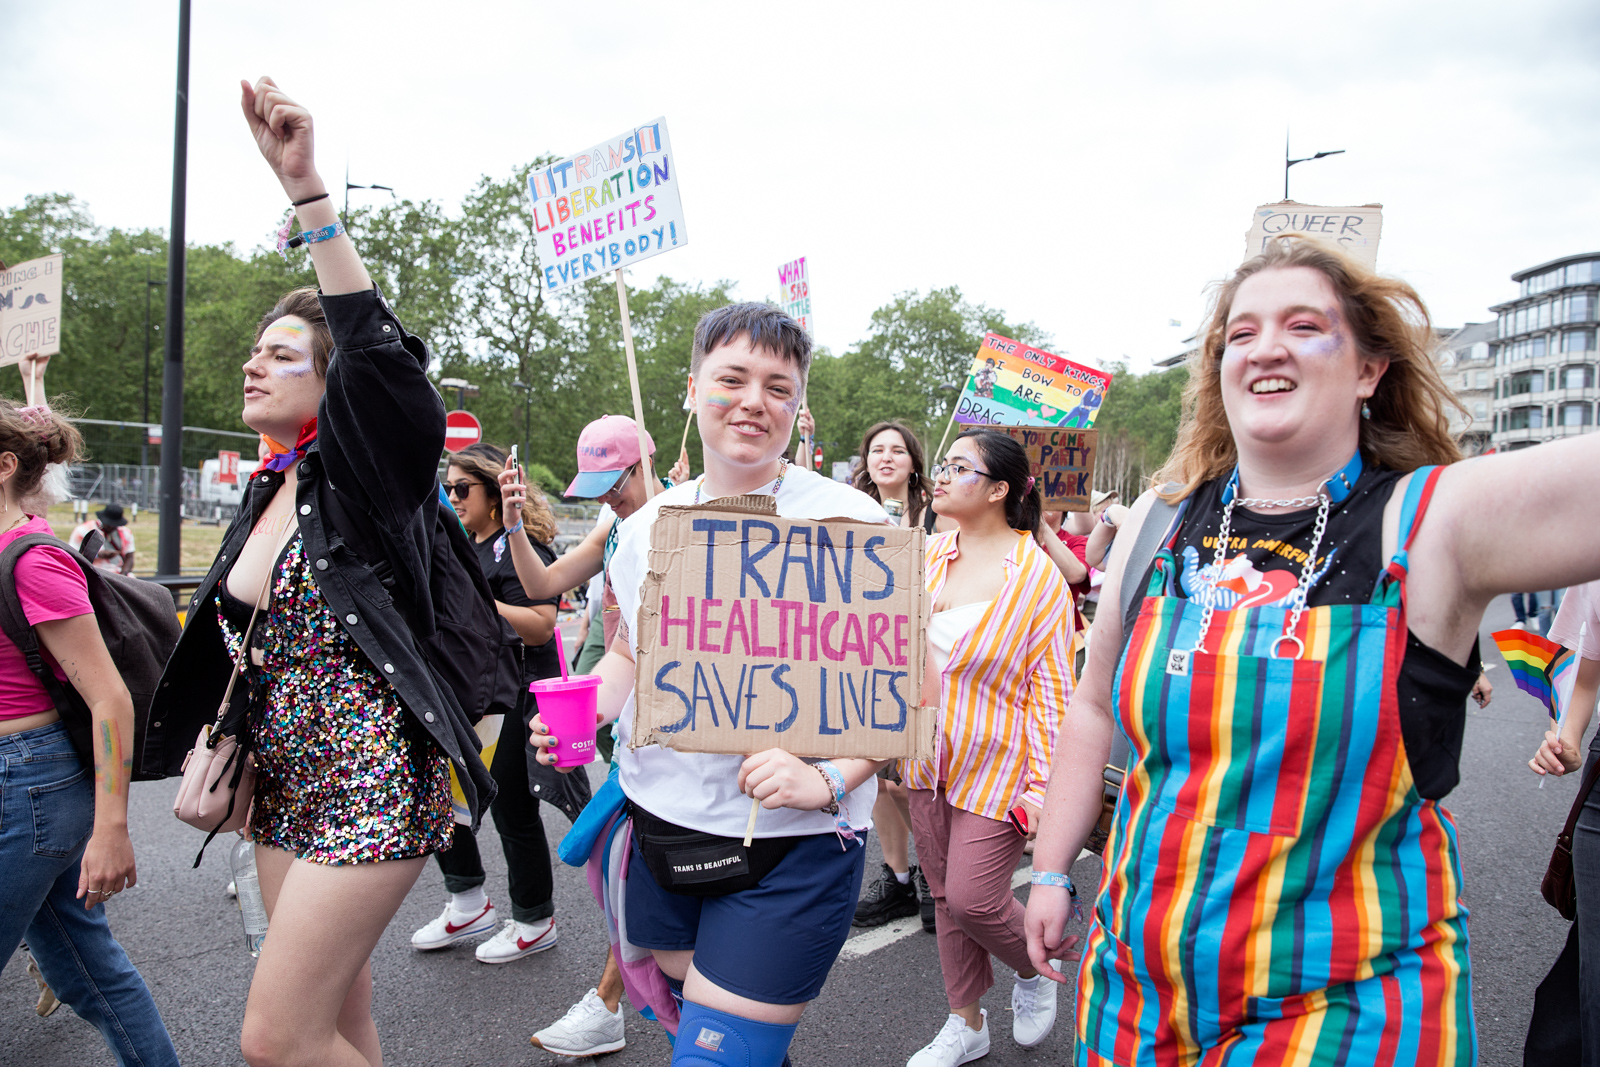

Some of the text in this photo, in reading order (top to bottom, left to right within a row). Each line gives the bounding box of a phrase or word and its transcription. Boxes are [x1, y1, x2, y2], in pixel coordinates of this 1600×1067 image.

[553, 136, 636, 189] TRANS
[533, 154, 670, 234] LIBERATION
[552, 195, 657, 257] BENEFITS
[1262, 213, 1364, 236] QUEER
[544, 220, 678, 289] EVERYBODY!
[778, 257, 805, 286] WHAT
[781, 281, 808, 303] A SAD
[0, 317, 57, 359] CHE
[988, 337, 1106, 387] THE ONLY KINGS
[996, 360, 1082, 397] I BOW TO
[1013, 384, 1043, 404] ARE
[1022, 430, 1046, 447] YOU
[1050, 431, 1085, 448] CAME
[1040, 445, 1091, 467] PARTY
[1043, 471, 1090, 498] WORK
[692, 518, 895, 604] TRANS
[660, 595, 909, 667] HEALTHCARE
[654, 660, 908, 736] SAVES LIVES
[571, 739, 594, 749] COSTA
[704, 855, 742, 870] BEAUTIFUL
[699, 1029, 721, 1043] LP
